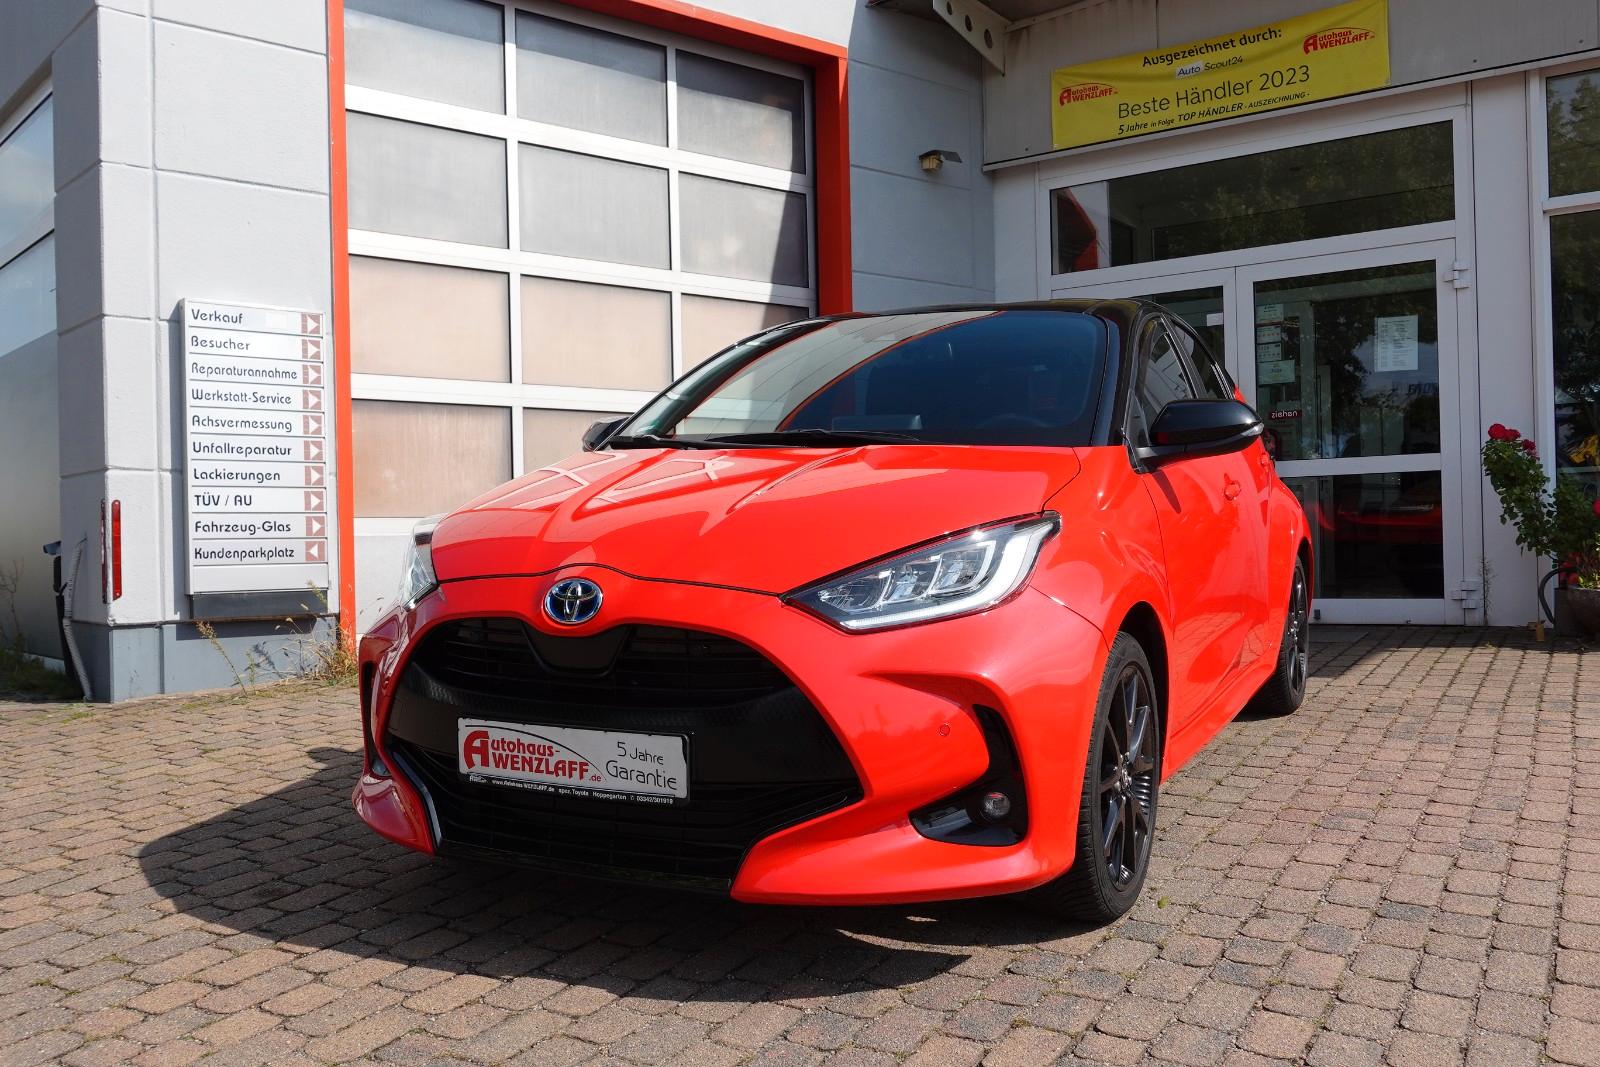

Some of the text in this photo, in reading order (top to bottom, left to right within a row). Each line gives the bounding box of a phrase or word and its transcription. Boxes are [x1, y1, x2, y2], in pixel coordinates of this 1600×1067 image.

[1142, 27, 1282, 67] Ausgezeichnet durch:
[1118, 64, 1310, 119] Beste Händler 2023
[1118, 124, 1125, 135] 5
[1125, 121, 1148, 133] Jahre
[1157, 118, 1175, 127] Folge
[1178, 111, 1197, 122] TOP
[1198, 102, 1243, 118] HÄNDLER
[191, 308, 243, 324] Verkauf
[191, 335, 251, 350] Besucher
[191, 362, 298, 379] Reparaturannahme
[191, 388, 292, 404] Werkstatt-Service
[192, 415, 292, 432] Achsvermessung
[193, 441, 292, 457] Unfallreparatur
[193, 468, 281, 483] Lackierungen
[194, 491, 221, 506] TÜV
[234, 494, 252, 506] AU
[194, 520, 292, 535] Fahrzeug-Glas
[194, 546, 295, 562] Kundenparkplatz
[617, 741, 664, 765] 5 Jahre
[605, 760, 677, 790] Garantie
[572, 788, 589, 797] Toyota
[592, 791, 627, 800] Hoppegarten
